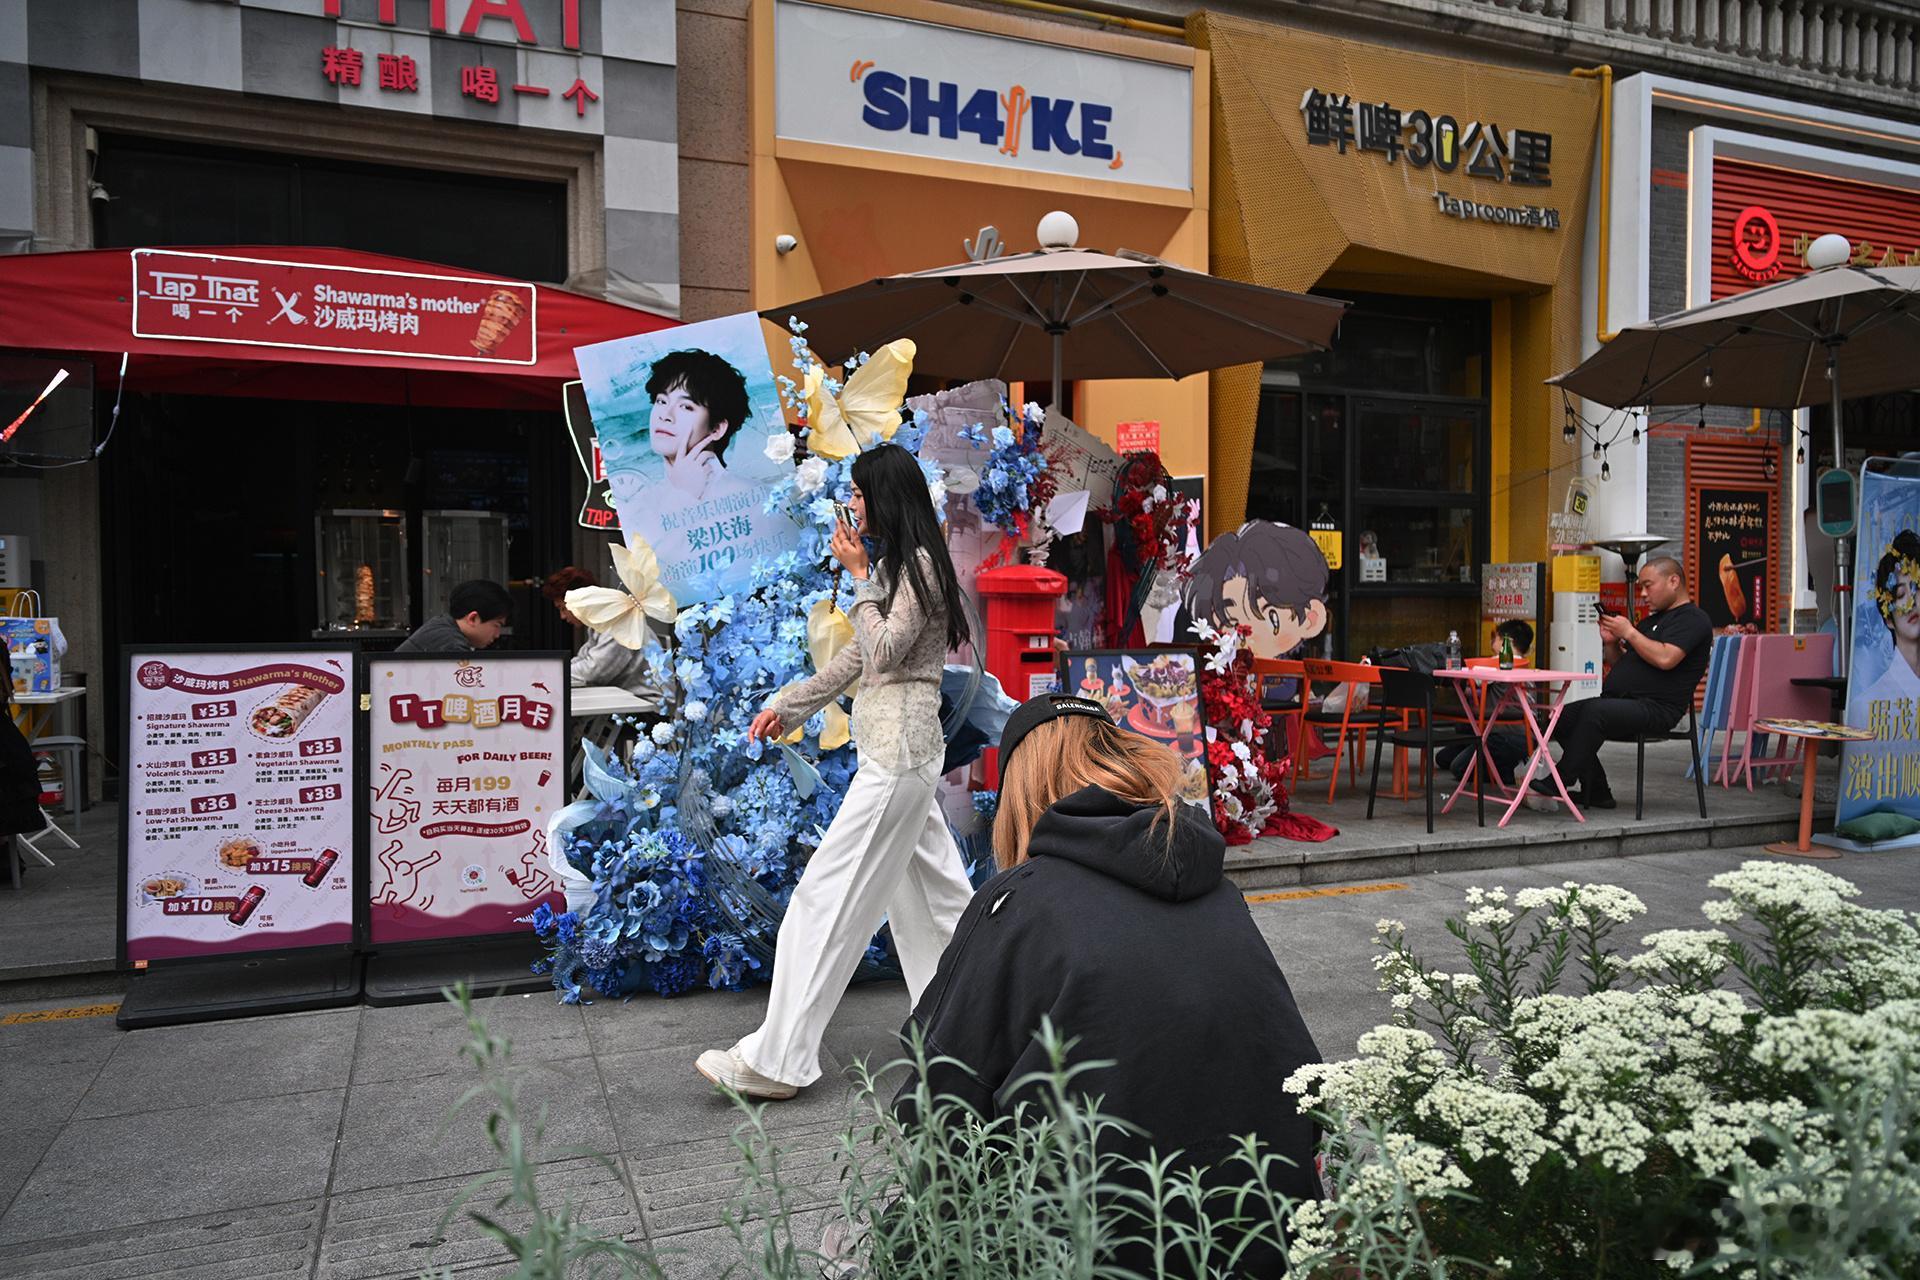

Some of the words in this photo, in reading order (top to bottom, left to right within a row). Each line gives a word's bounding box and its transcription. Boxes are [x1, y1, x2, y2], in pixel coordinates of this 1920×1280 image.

[321, 46, 419, 93] 精酿
[461, 65, 599, 118] 喝一个
[1300, 88, 1552, 187] 鲜啤30公里
[149, 271, 198, 300] Tap
[201, 275, 259, 303] That
[313, 284, 418, 310] Shawarma's
[421, 297, 481, 315] mother
[171, 303, 243, 323] 喝一个
[313, 305, 420, 336] 沙威玛烤肉
[586, 508, 613, 528] TAP
[686, 514, 753, 552] 梁庆海
[172, 673, 230, 690] 沙威玛烤肉
[232, 669, 300, 689] Shawarma's
[302, 671, 340, 690] Mother
[199, 703, 230, 718] ¥35
[306, 740, 335, 754] ¥35
[382, 740, 440, 753] MONTHLY
[443, 739, 474, 750] PASS
[145, 761, 186, 769] 火山沙威玛
[198, 751, 229, 766] ¥35
[457, 752, 480, 764] FOR
[483, 751, 517, 762] DAILY
[520, 751, 552, 761] BEER!
[436, 776, 511, 793] 每月199
[198, 796, 230, 811] ¥36
[255, 798, 293, 806] 芝士沙威玛
[306, 786, 336, 801] ¥38
[432, 797, 520, 816] 天天都有酒
[180, 815, 223, 823] Shawarma
